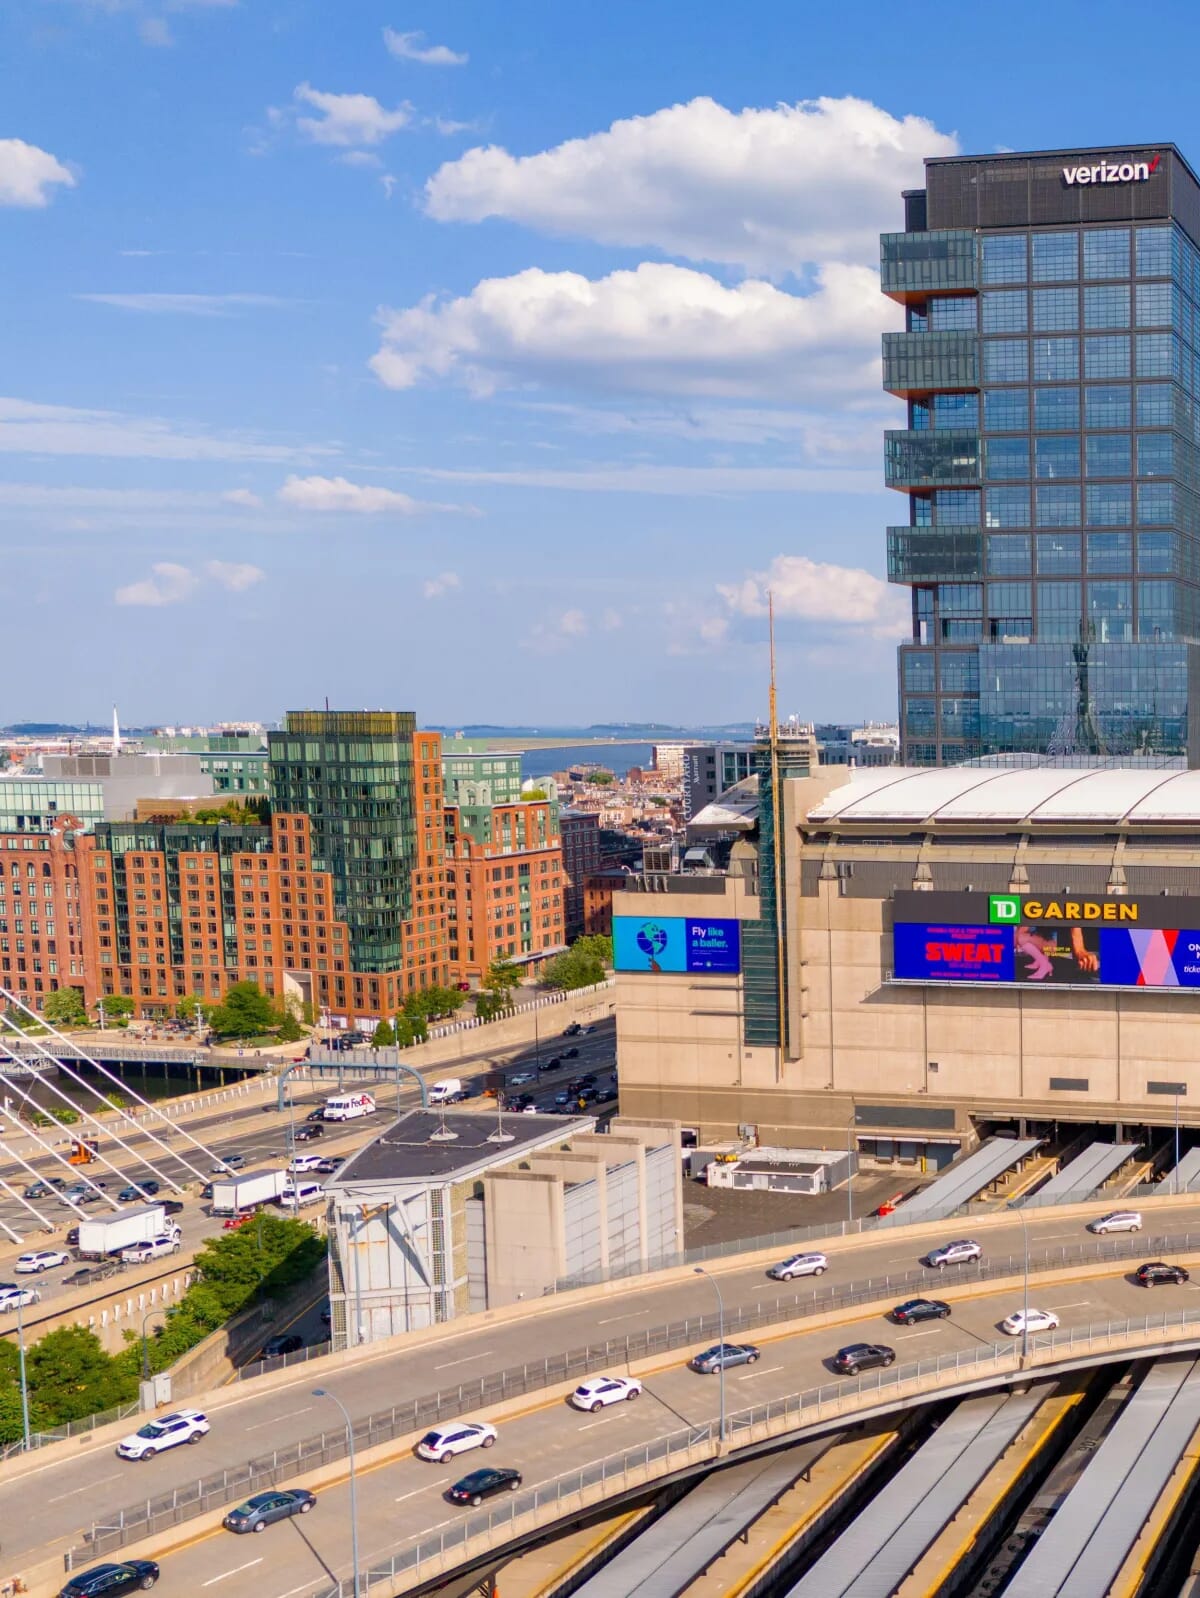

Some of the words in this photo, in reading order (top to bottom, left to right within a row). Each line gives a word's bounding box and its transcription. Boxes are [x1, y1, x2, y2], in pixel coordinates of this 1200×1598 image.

[1062, 160, 1149, 185] verizon
[683, 754, 692, 821] COURTYARD
[992, 900, 1017, 919] TD
[1023, 901, 1139, 921] GARDEN
[692, 926, 706, 938] Fly
[707, 927, 724, 937] like
[926, 942, 1005, 963] SWEAT
[350, 1095, 373, 1109] FedEx
